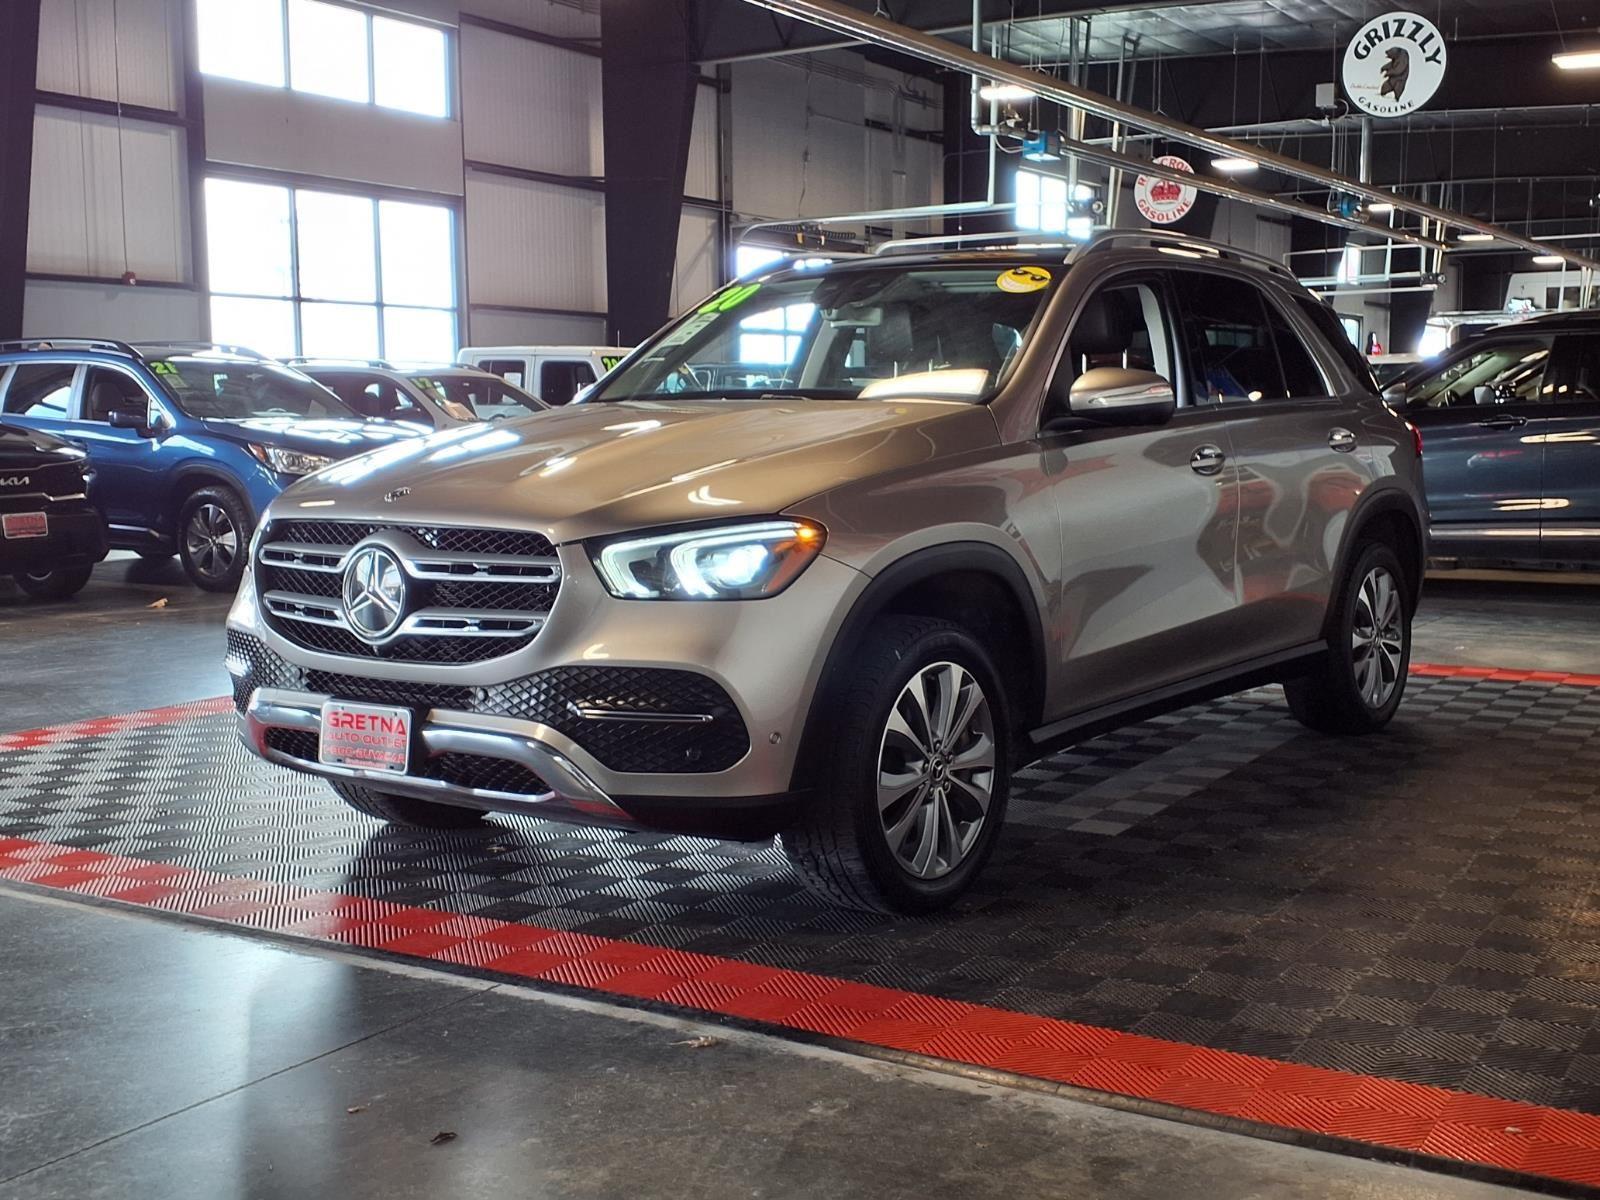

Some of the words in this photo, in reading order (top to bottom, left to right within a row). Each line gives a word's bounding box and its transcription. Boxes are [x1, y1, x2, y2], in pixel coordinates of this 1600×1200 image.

[1353, 18, 1442, 65] GRIZZLY
[1358, 96, 1414, 113] GASOLINE
[1138, 198, 1192, 221] GASOLINE
[328, 711, 406, 735] GRETNA
[327, 731, 360, 743] UTO
